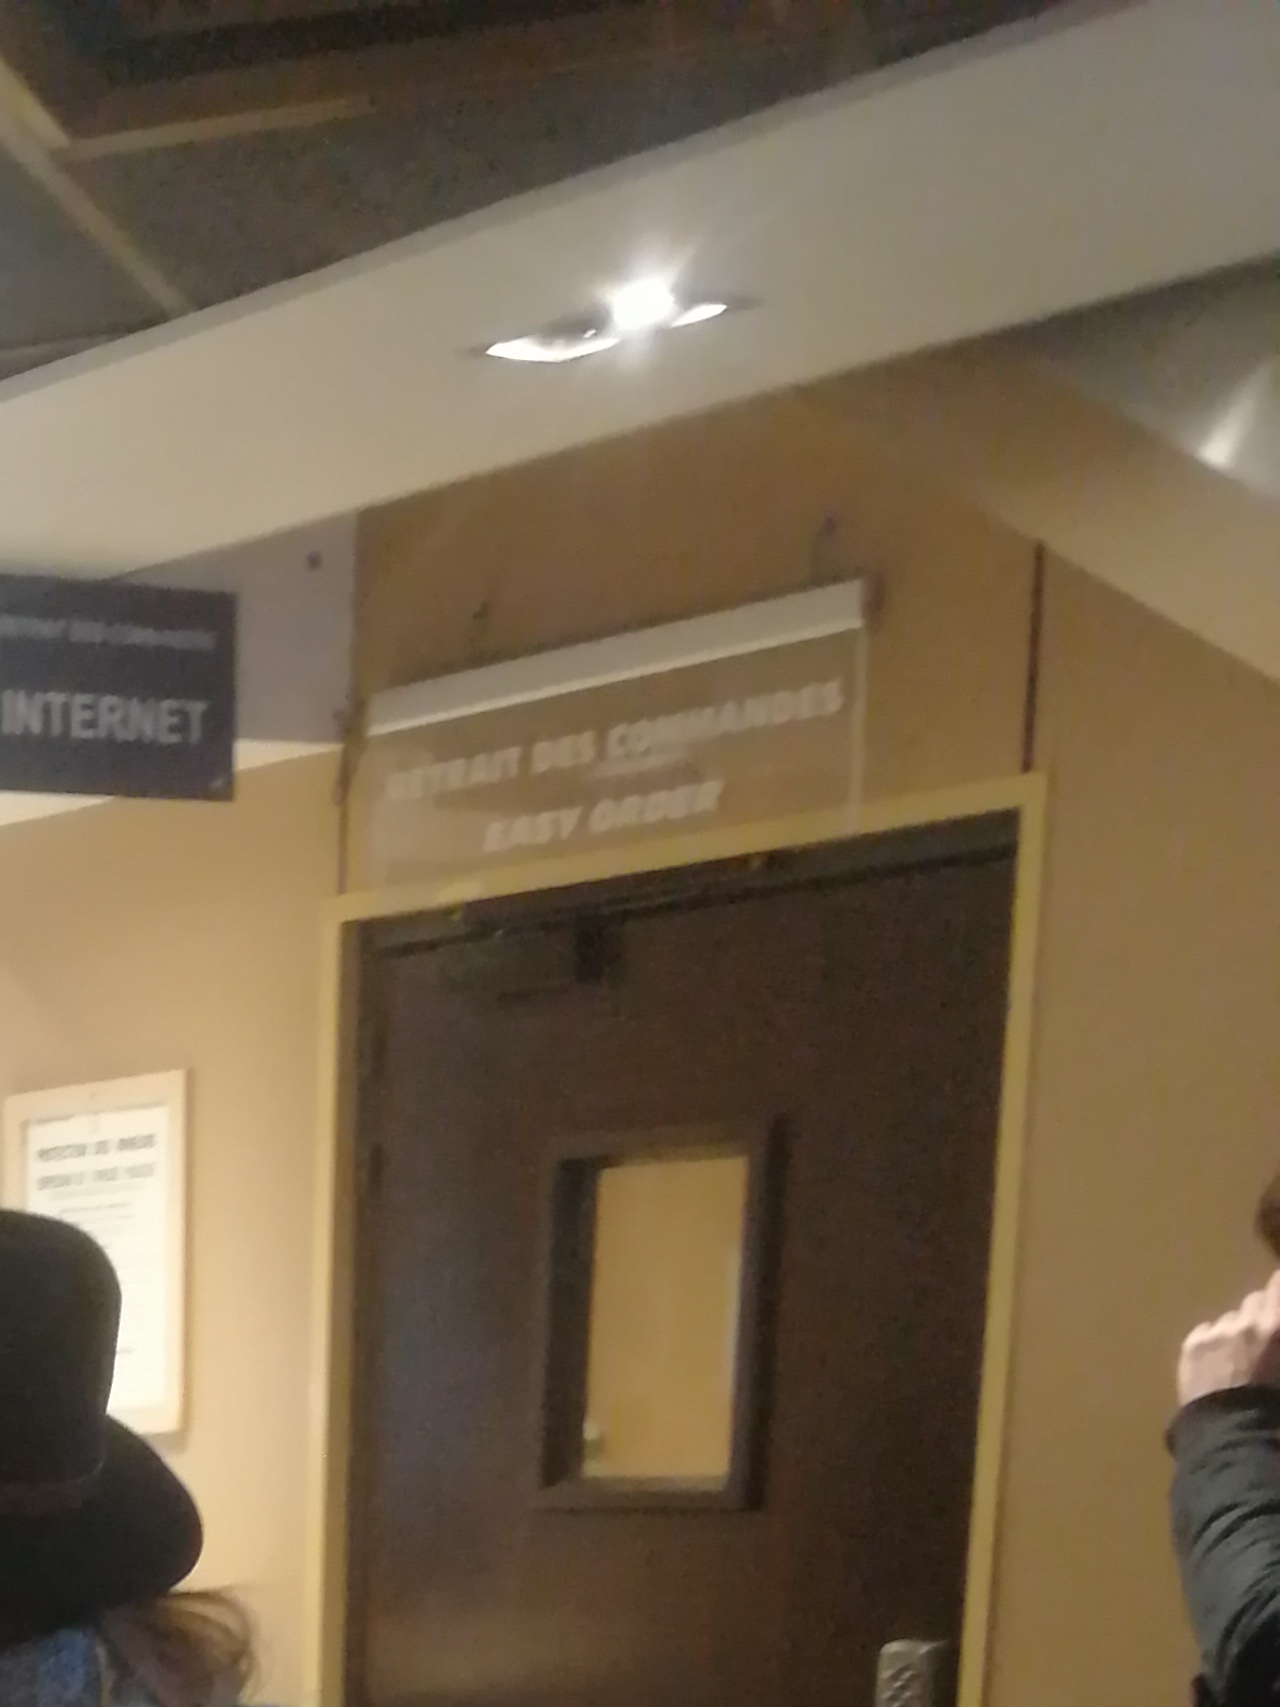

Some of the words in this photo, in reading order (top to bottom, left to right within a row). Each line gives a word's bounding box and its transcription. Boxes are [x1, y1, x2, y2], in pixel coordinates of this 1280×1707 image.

[1, 689, 209, 745] INTERNET
[531, 730, 597, 776] DES
[605, 678, 845, 760] COMMANDES
[482, 804, 584, 852] EASY
